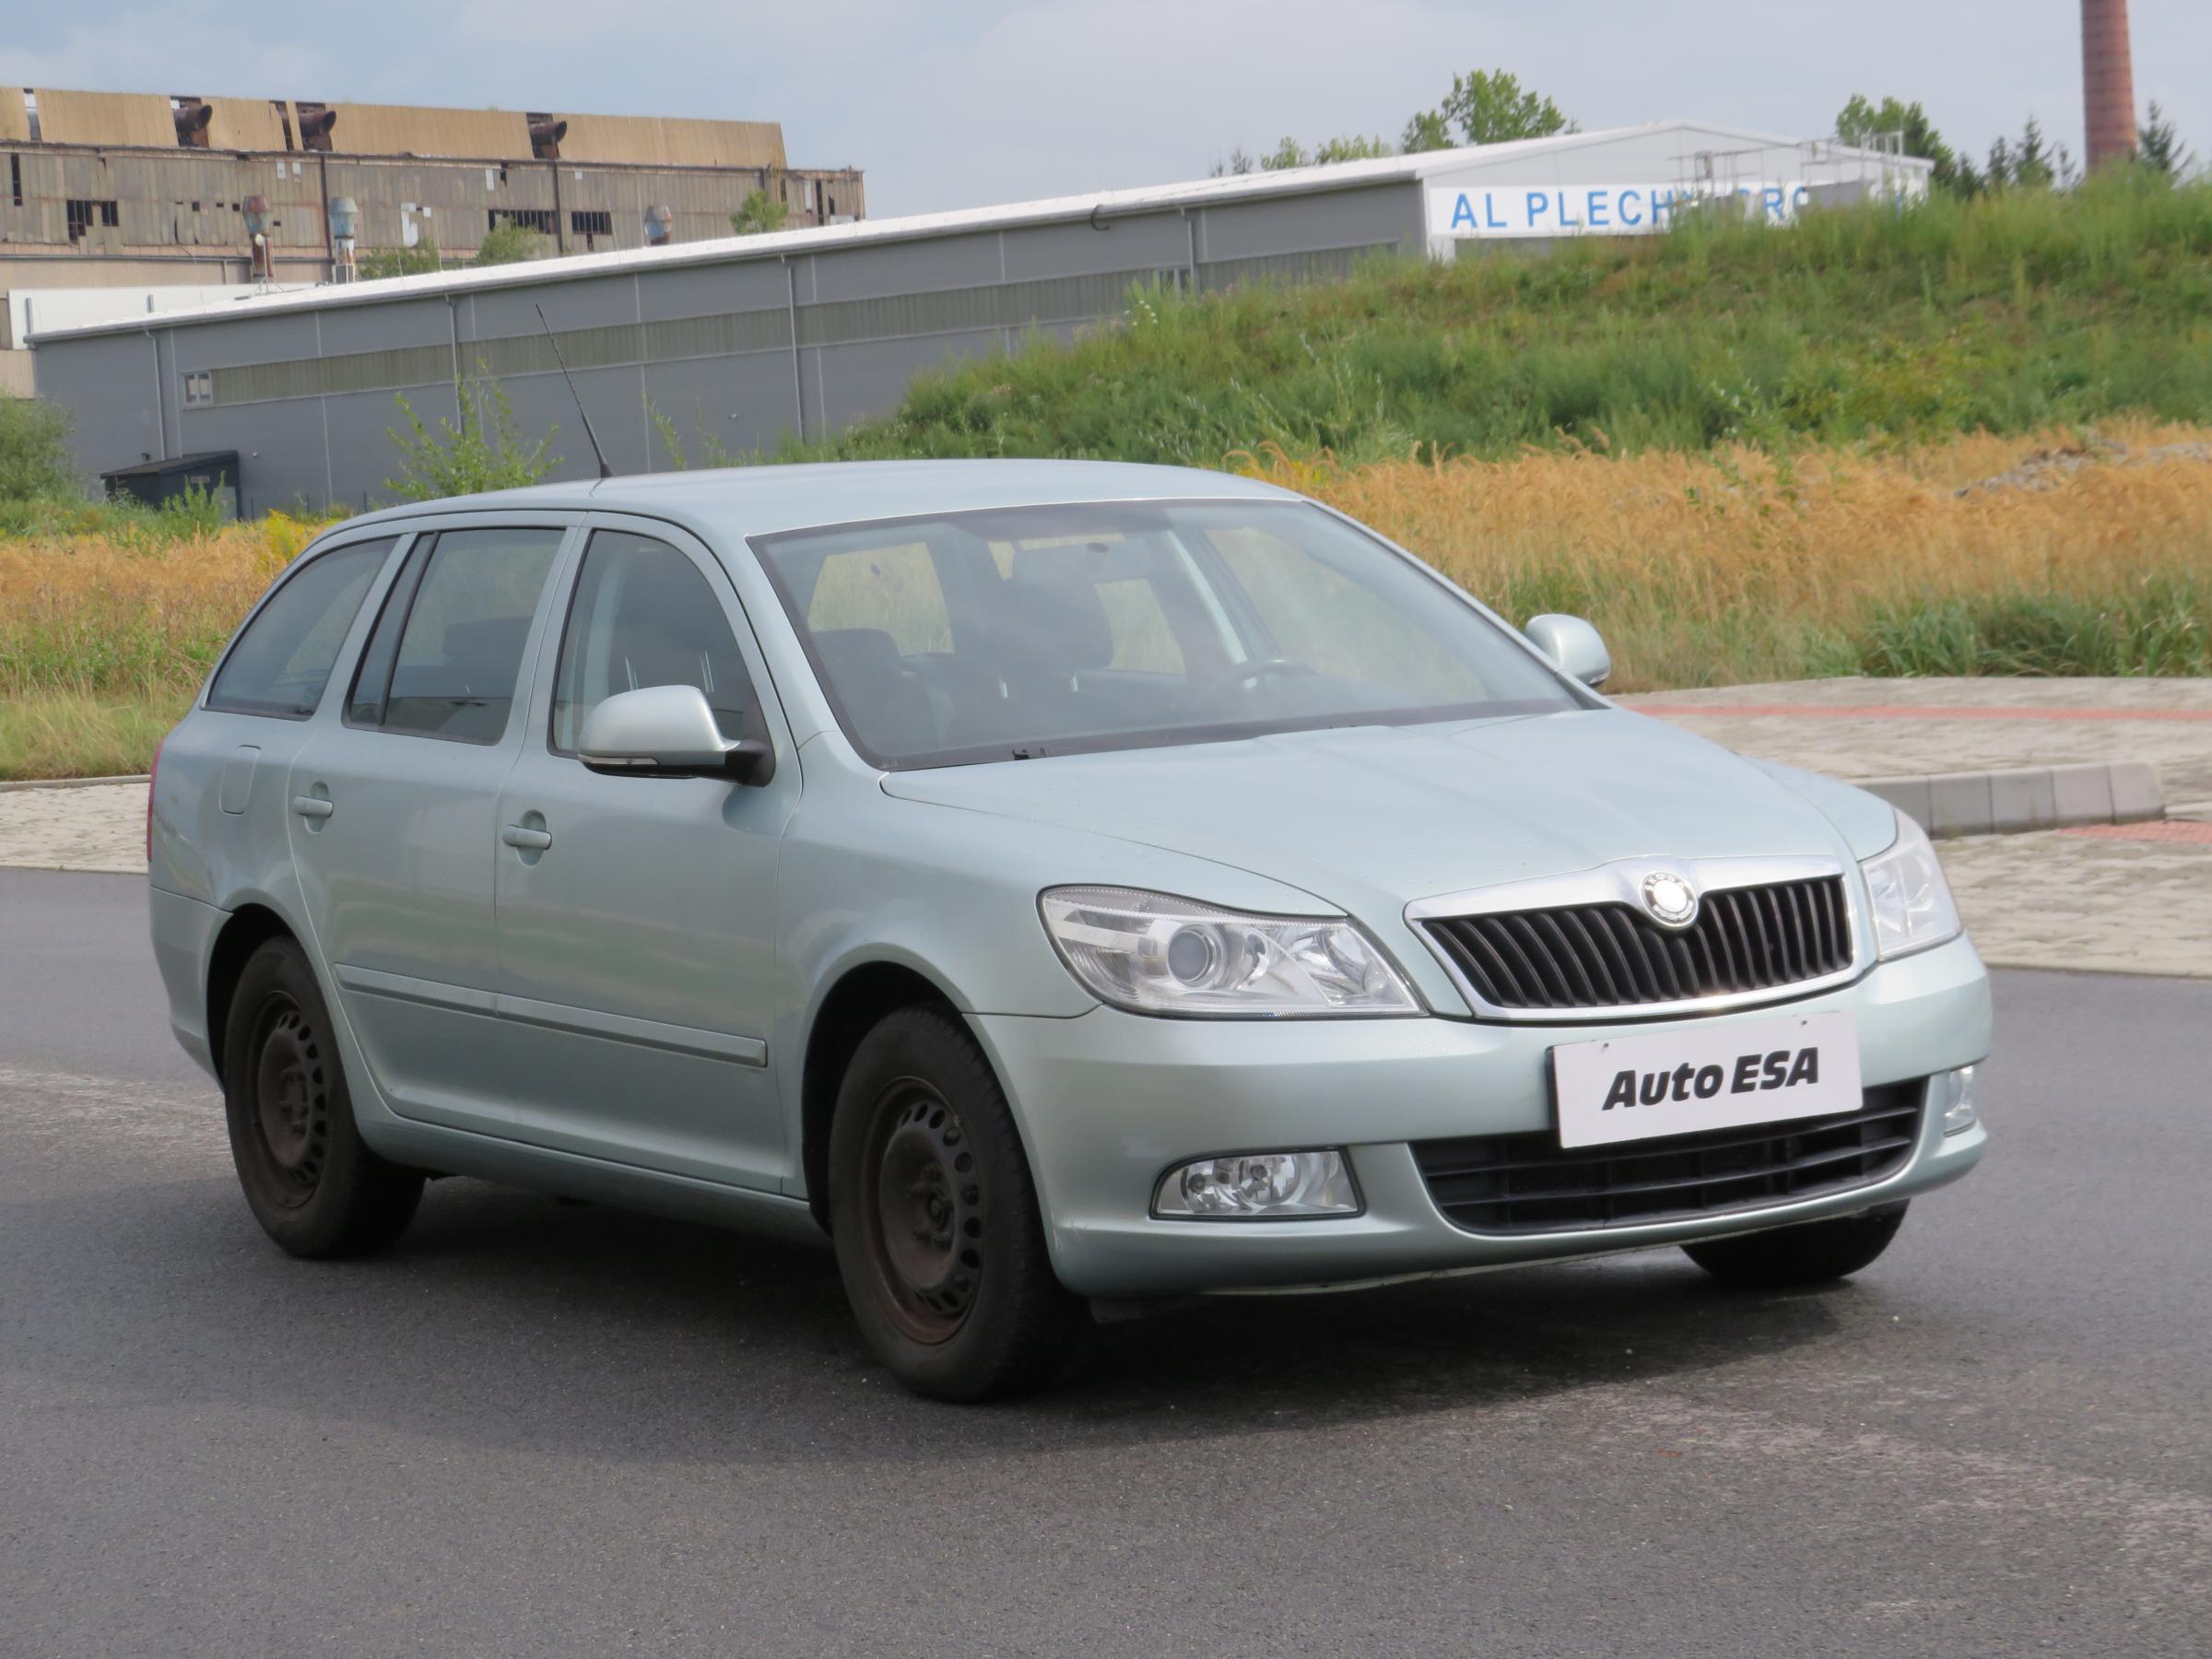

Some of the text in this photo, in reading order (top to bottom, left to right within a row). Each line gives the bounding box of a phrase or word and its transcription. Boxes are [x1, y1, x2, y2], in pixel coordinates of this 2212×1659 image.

[1451, 193, 1508, 229] AL
[1602, 1046, 1818, 1111] Auto ESA
